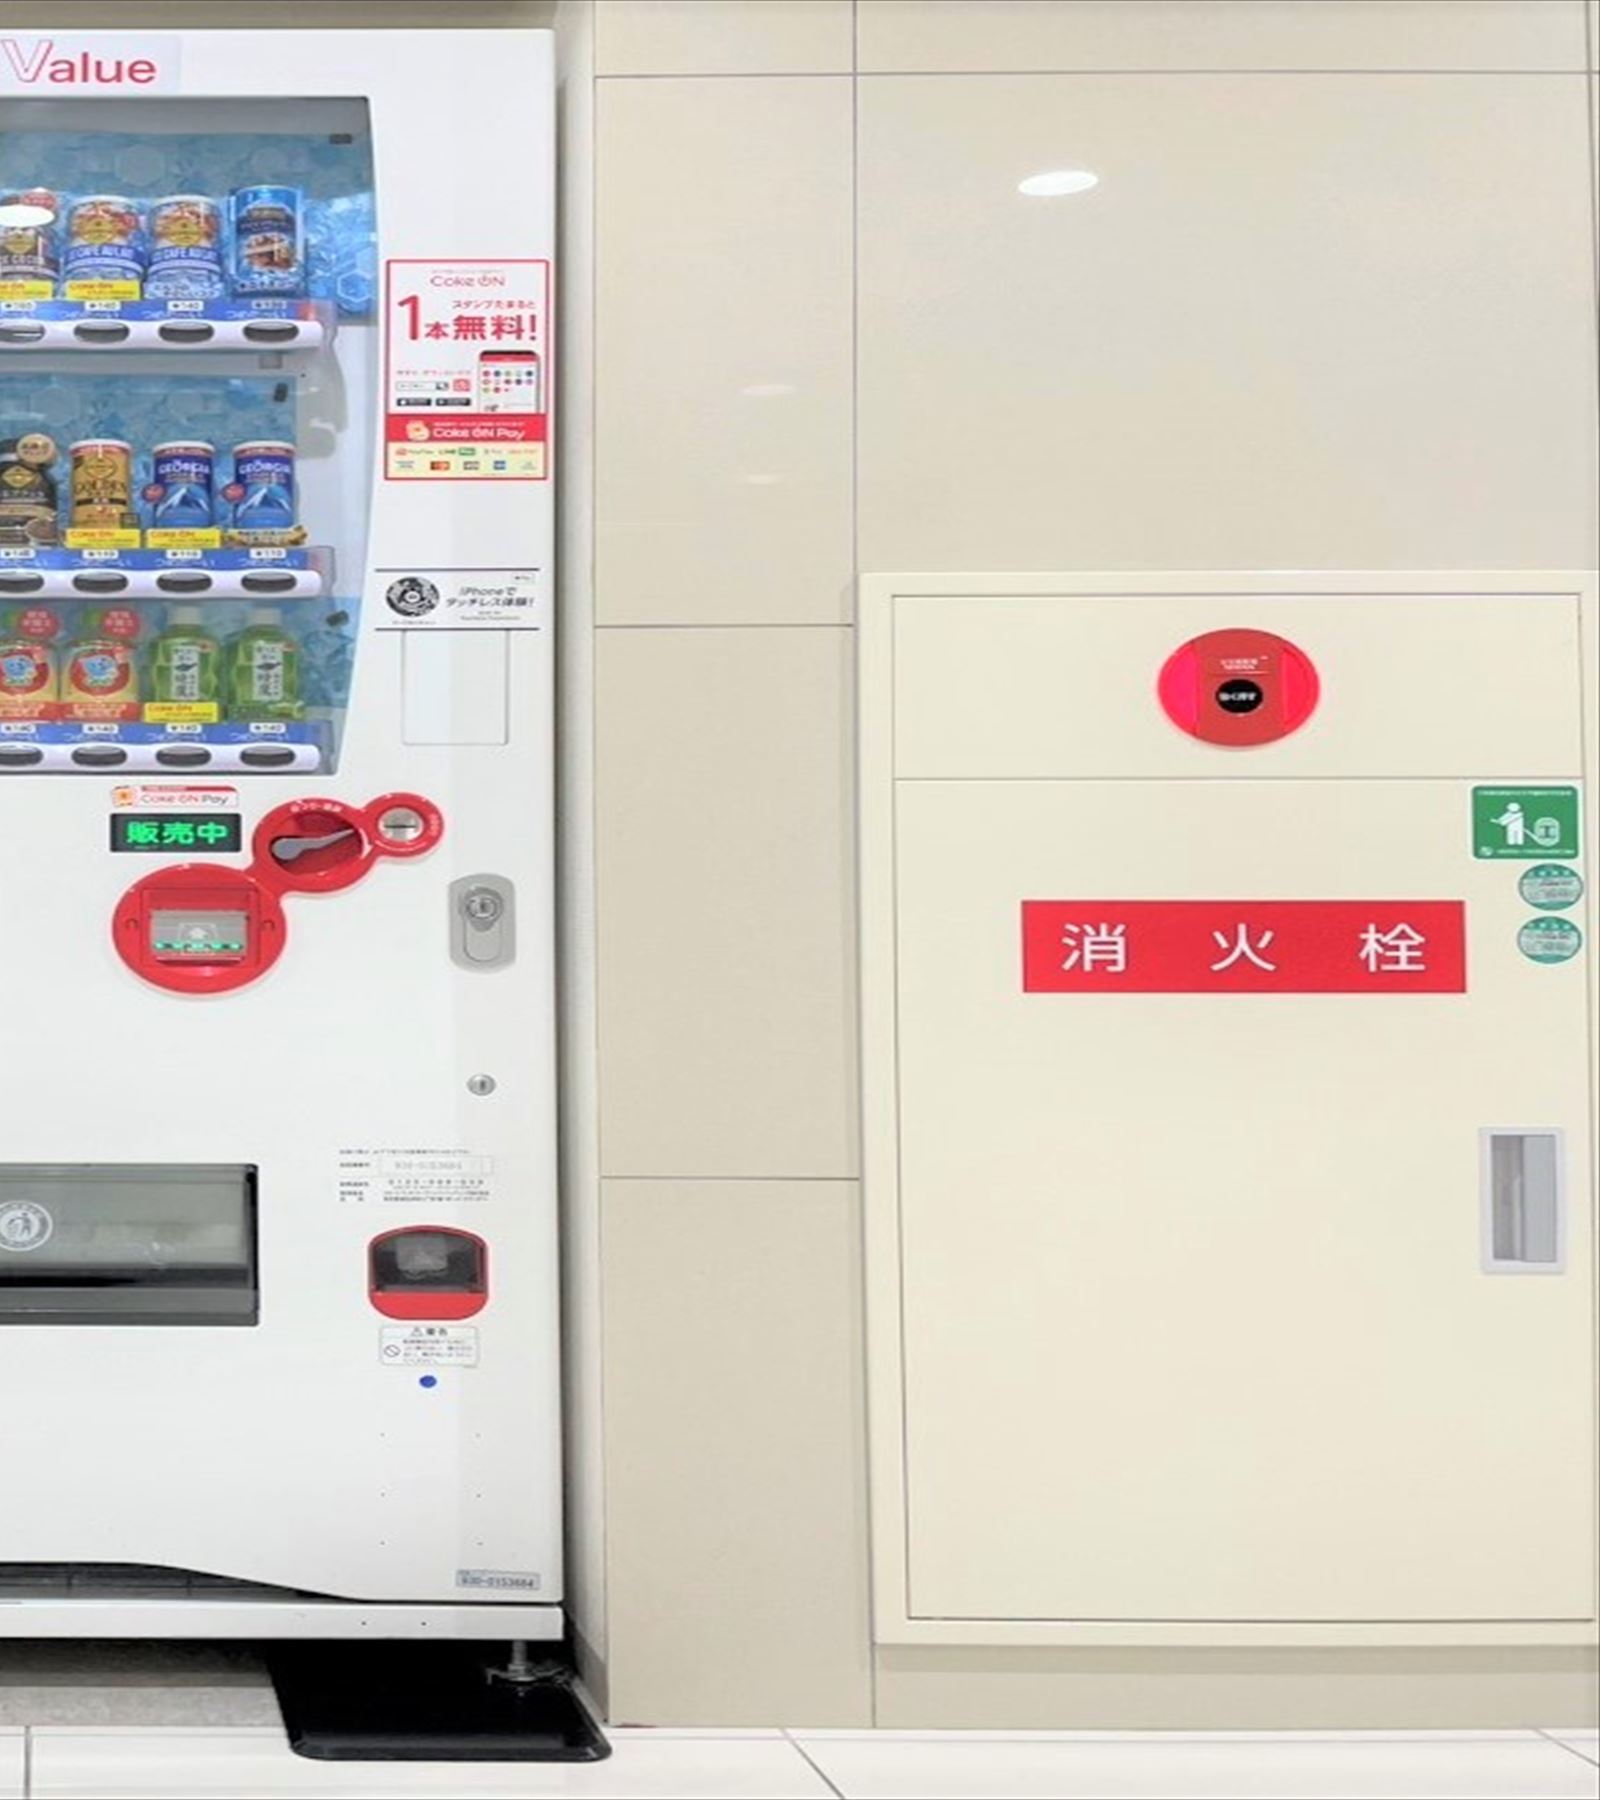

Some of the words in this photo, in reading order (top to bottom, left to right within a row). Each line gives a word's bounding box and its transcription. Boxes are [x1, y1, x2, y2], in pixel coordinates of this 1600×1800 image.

[1, 39, 157, 83] Value
[127, 821, 228, 844] 販売中
